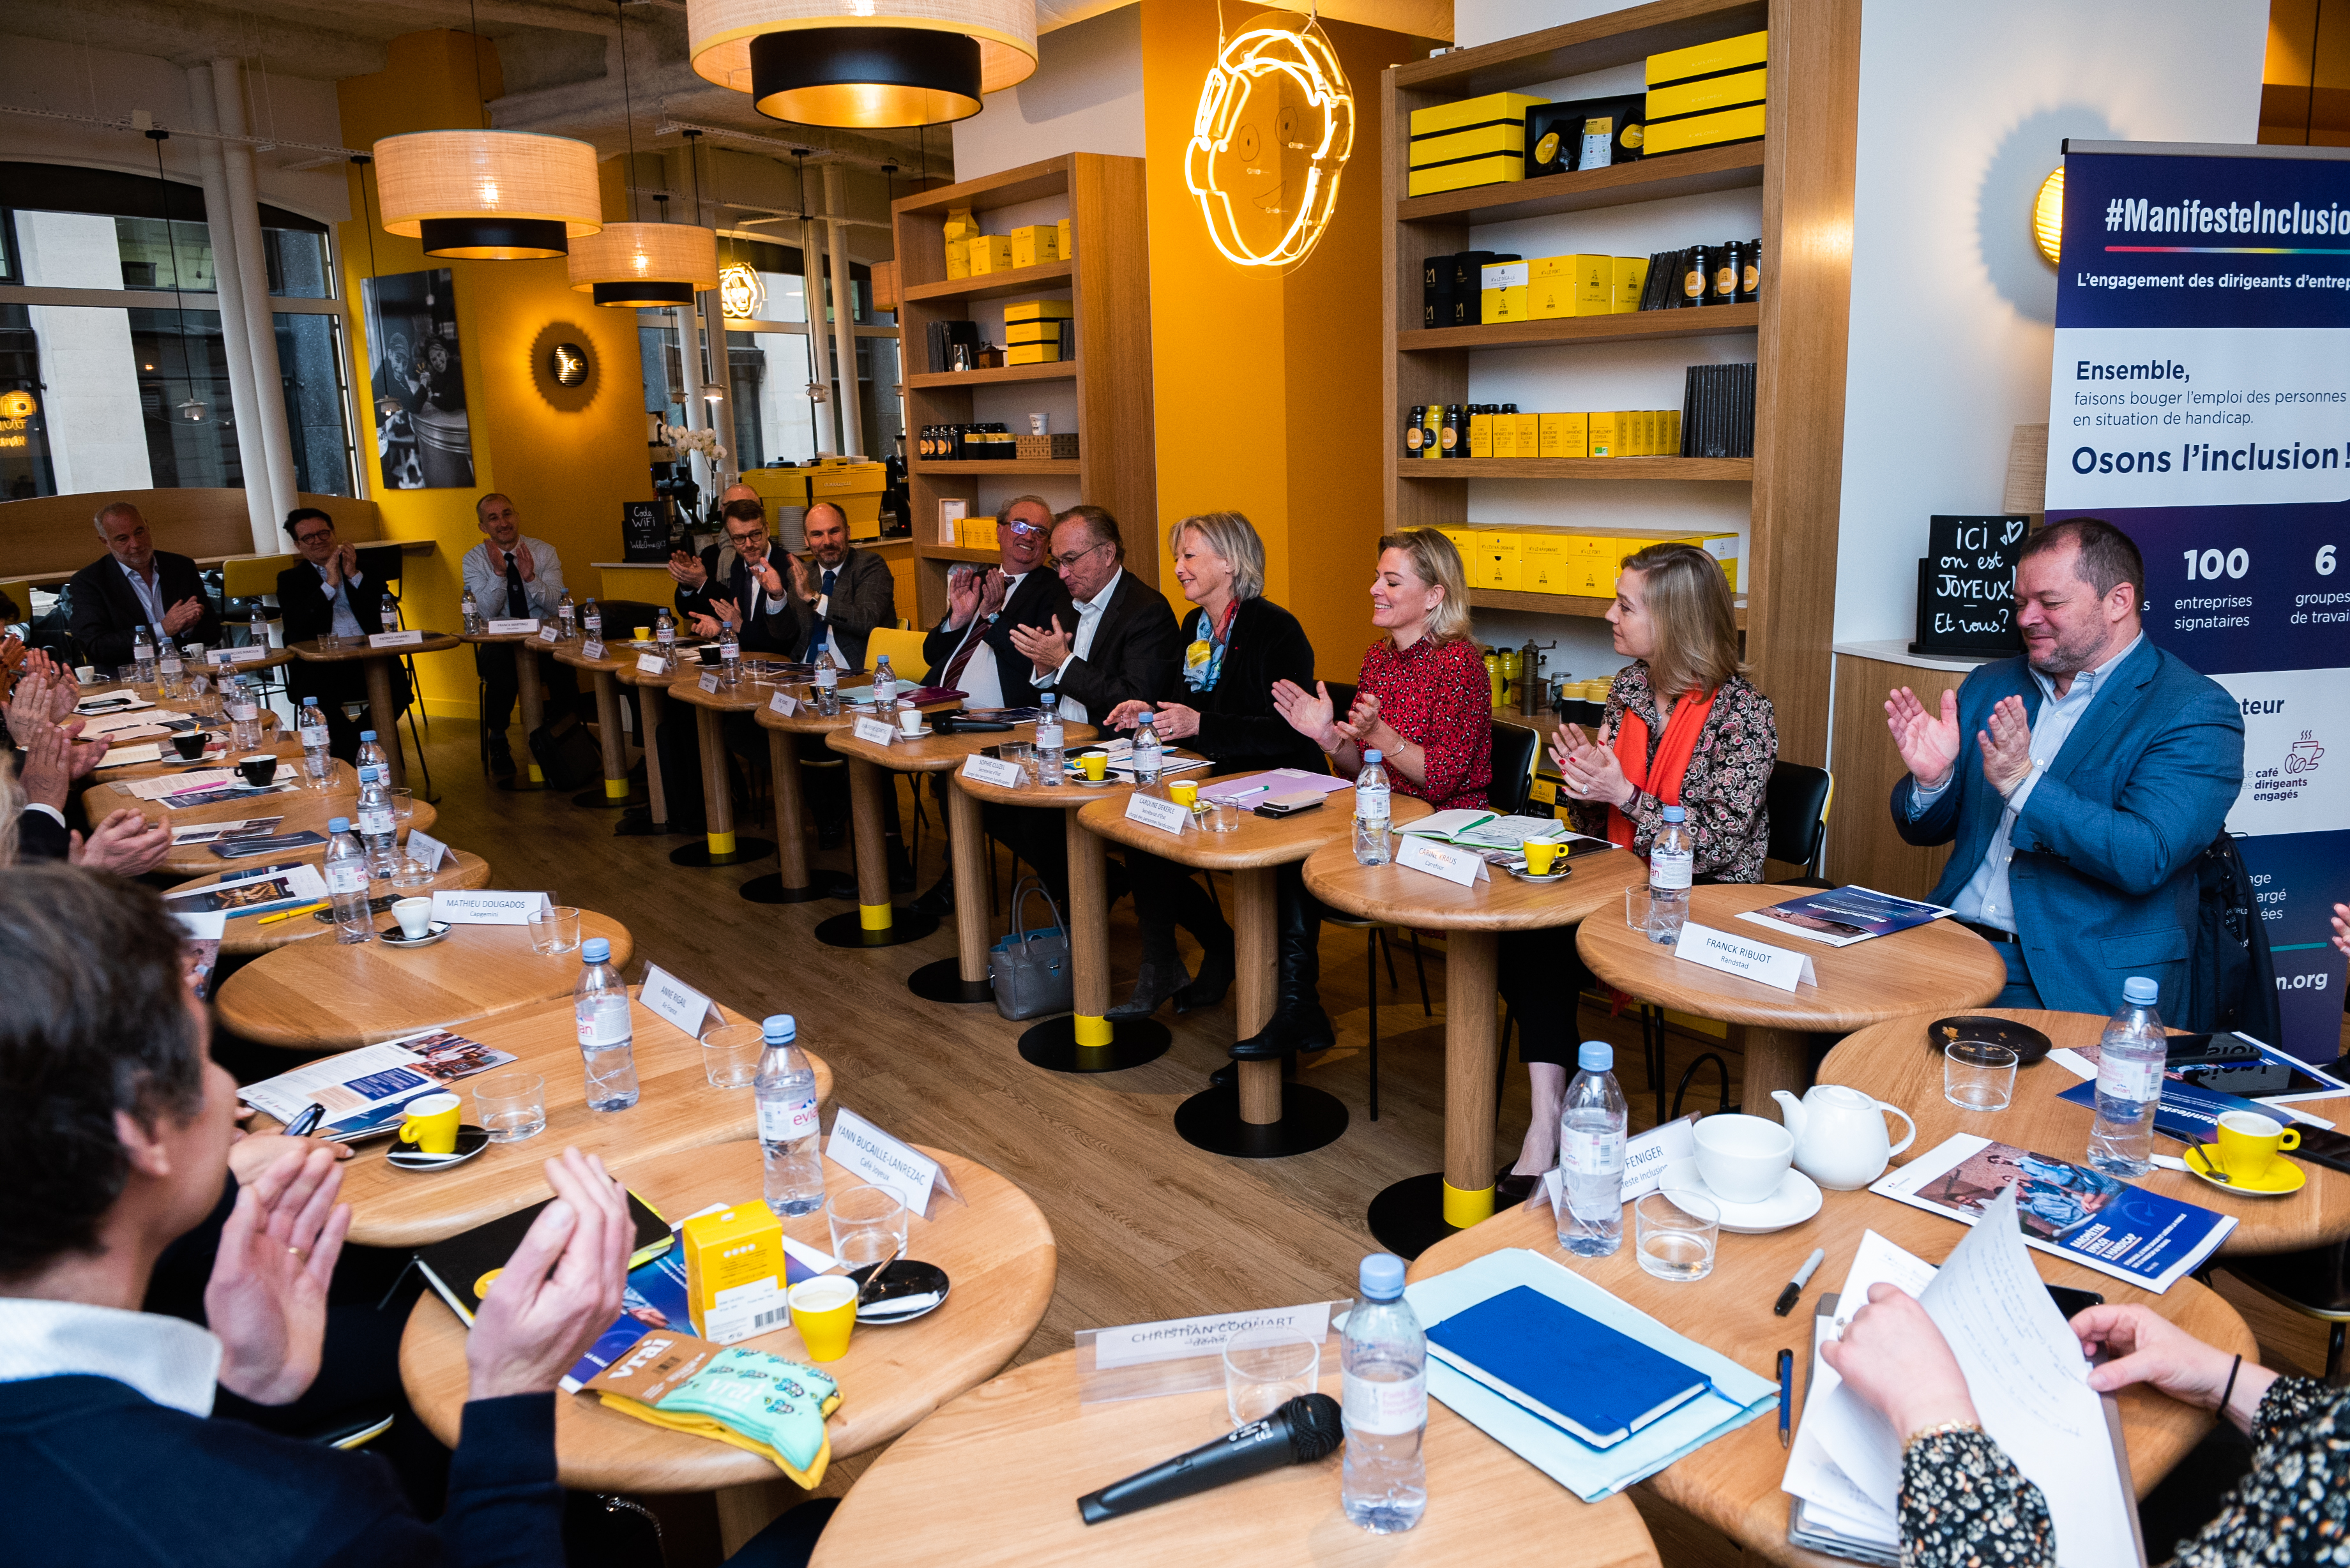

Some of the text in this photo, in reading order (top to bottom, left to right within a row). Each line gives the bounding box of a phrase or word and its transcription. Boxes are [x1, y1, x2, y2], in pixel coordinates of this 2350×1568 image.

[2077, 273, 2184, 290] L'engagement
[2188, 274, 2215, 287] des
[2218, 273, 2291, 290] dirigeants
[2077, 359, 2190, 383] Ensemble,
[2075, 390, 2347, 407] faisons bouger l'emploi des personnes
[2073, 411, 2254, 426] en situation de handicap.
[2072, 446, 2171, 474] Osons
[2183, 441, 2339, 471] l'inclusion
[633, 506, 653, 517] Code
[1940, 553, 2004, 570] on est
[2184, 545, 2337, 580] 100 6
[2174, 594, 2253, 612] entreprises
[2295, 592, 2350, 607] groupes
[1934, 612, 1955, 633] Et
[2174, 612, 2250, 631] signataires
[2291, 609, 2350, 624] de travai
[2237, 697, 2285, 716] teur
[992, 762, 1005, 771] CLUZEL
[2255, 767, 2278, 778] café
[2254, 776, 2308, 792] dirigeants
[2254, 788, 2299, 803] engagés
[1139, 798, 1176, 815] CAROLINE DEKERLE
[1418, 847, 1457, 865] CARINE KRAUS
[1425, 860, 1444, 871] Carrefour
[447, 900, 526, 910] MATHIEU DOUGADOS
[2257, 890, 2287, 905] argé
[469, 910, 499, 920] Capgemini
[2261, 908, 2284, 921] ées
[1706, 937, 1771, 964] FRANCK RIBUOT
[1720, 954, 1749, 970] Randstad
[2277, 973, 2329, 991] n.org
[660, 986, 687, 1008] ANNE RIGAIL
[667, 1004, 678, 1016] France
[793, 1106, 819, 1126] evia
[838, 1124, 926, 1186] YANN BUCAILLE-LANREZAC
[1625, 1146, 1664, 1170] FENIGER
[860, 1157, 890, 1182] Café Joyeux
[2070, 1223, 2106, 1248] BAROMÈTRE
[2085, 1237, 2111, 1254] EMPLOI
[1132, 1323, 1213, 1344] CHRISTIAN
[608, 1338, 673, 1379] vrai
